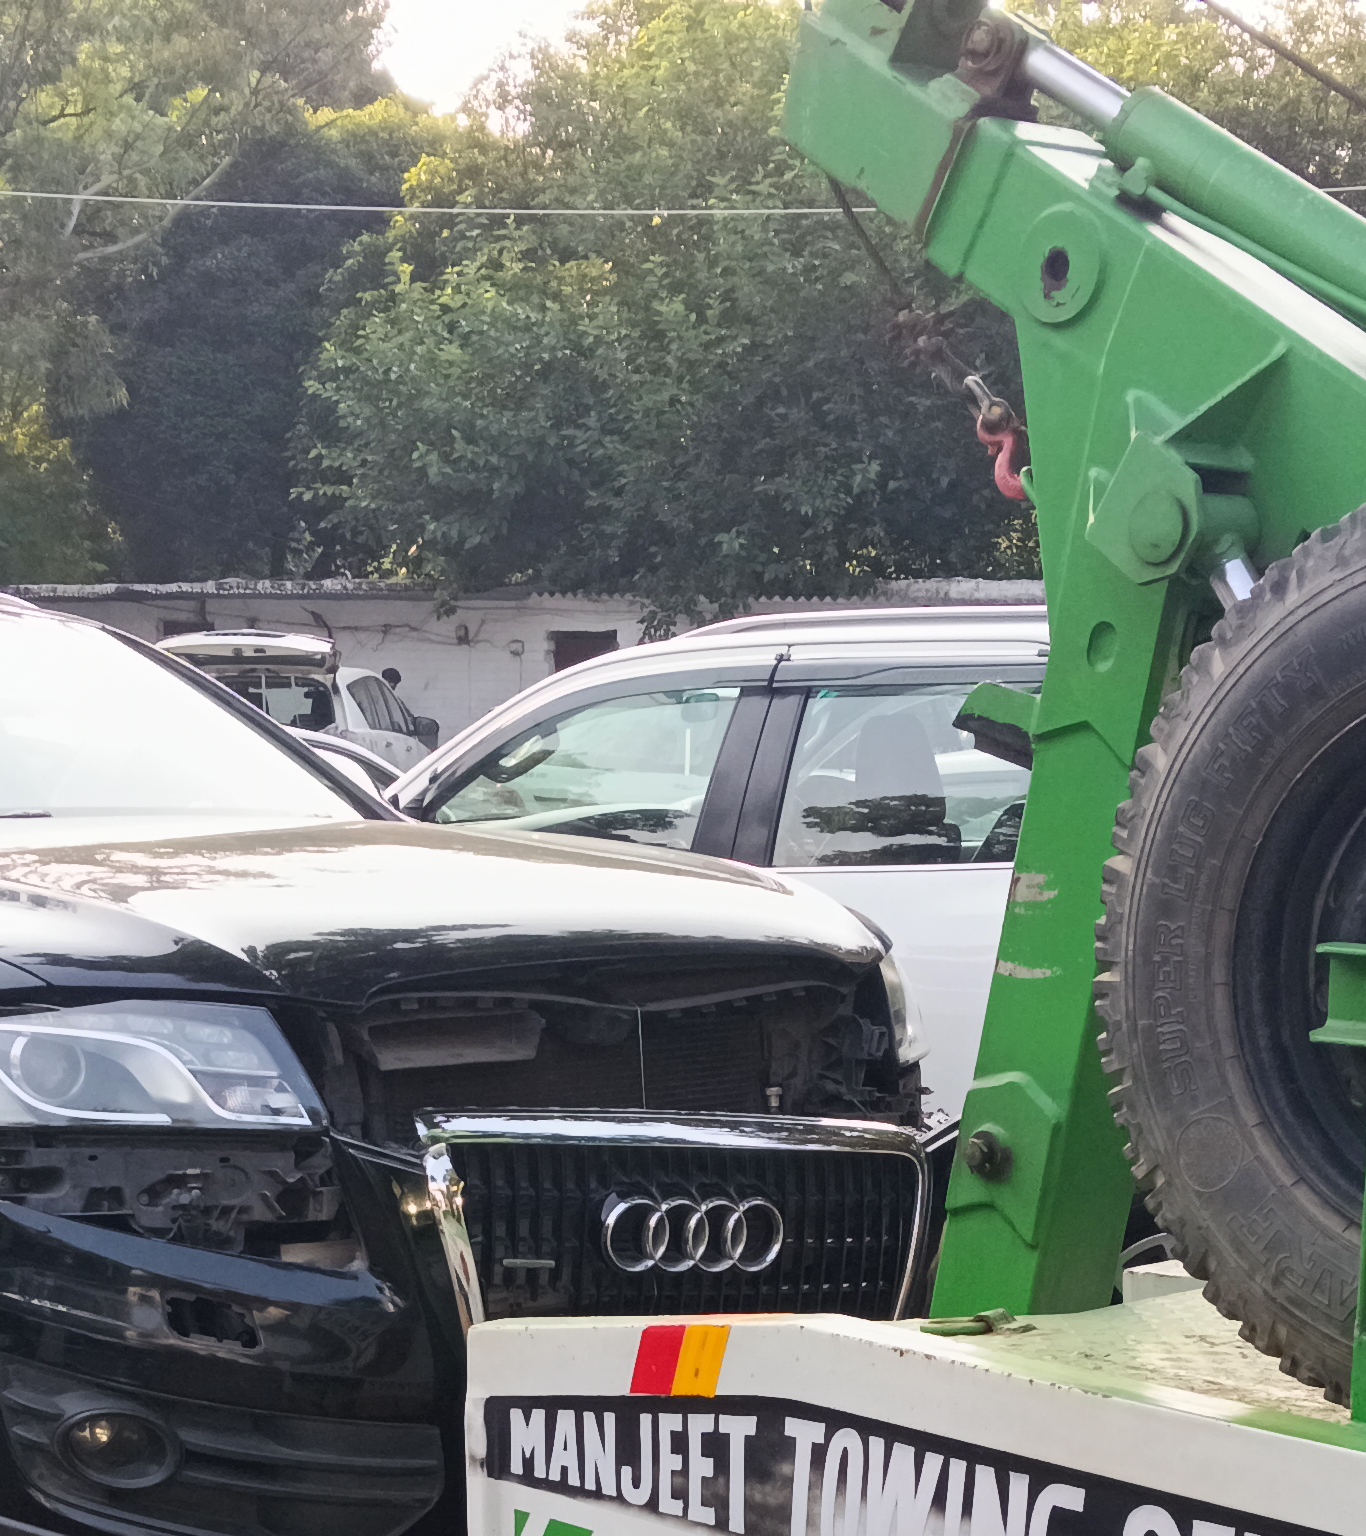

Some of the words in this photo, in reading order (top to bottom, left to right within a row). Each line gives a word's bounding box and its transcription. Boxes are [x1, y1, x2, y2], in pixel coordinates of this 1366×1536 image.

[1204, 645, 1325, 788] FIFTY
[1160, 798, 1216, 901] LUG
[1151, 920, 1198, 1096] SUPER
[510, 1407, 757, 1534] MANJEET
